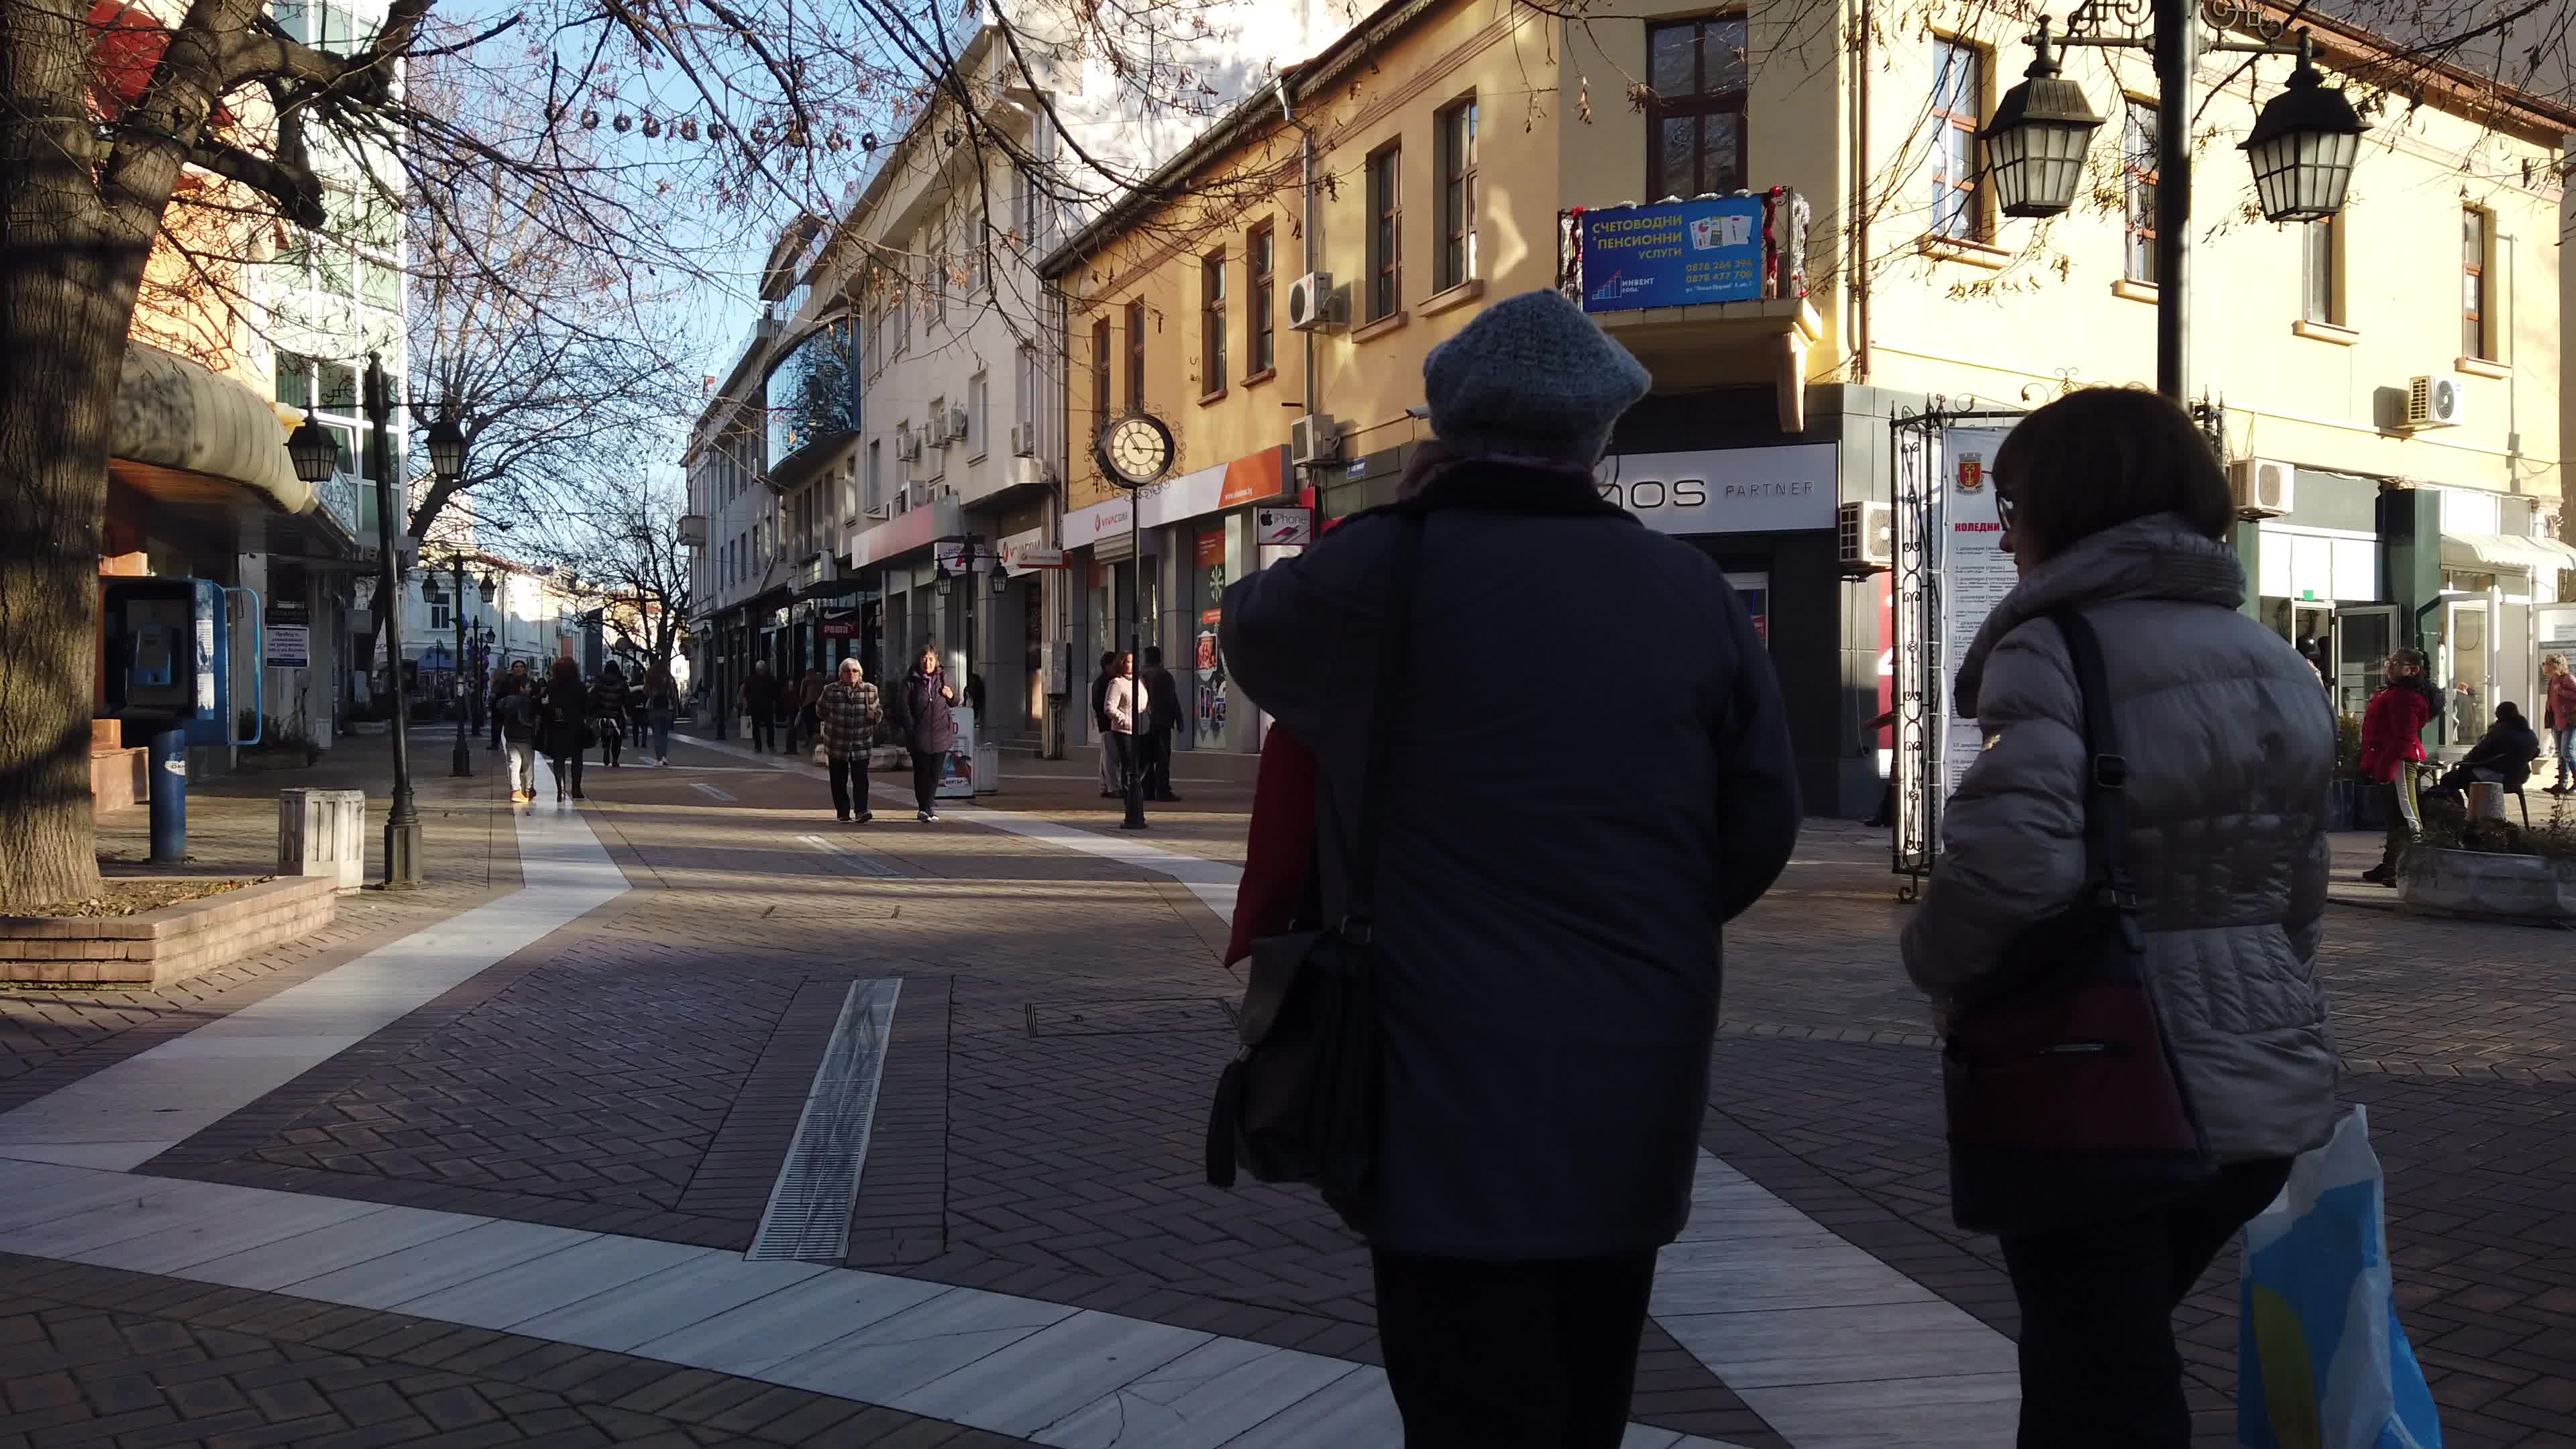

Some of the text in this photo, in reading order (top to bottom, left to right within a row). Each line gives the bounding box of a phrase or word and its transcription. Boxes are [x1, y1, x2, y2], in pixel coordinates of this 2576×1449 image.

[1593, 215, 1682, 233] СЧЕТОВОДНИ
[1599, 232, 1682, 250] ПЕНСИОННИ
[1639, 248, 1682, 259] УСЛУГИ
[1622, 278, 1655, 286] ИНВЕНТ
[1725, 482, 1815, 499] PARTNER
[1273, 513, 1306, 524] iPhone
